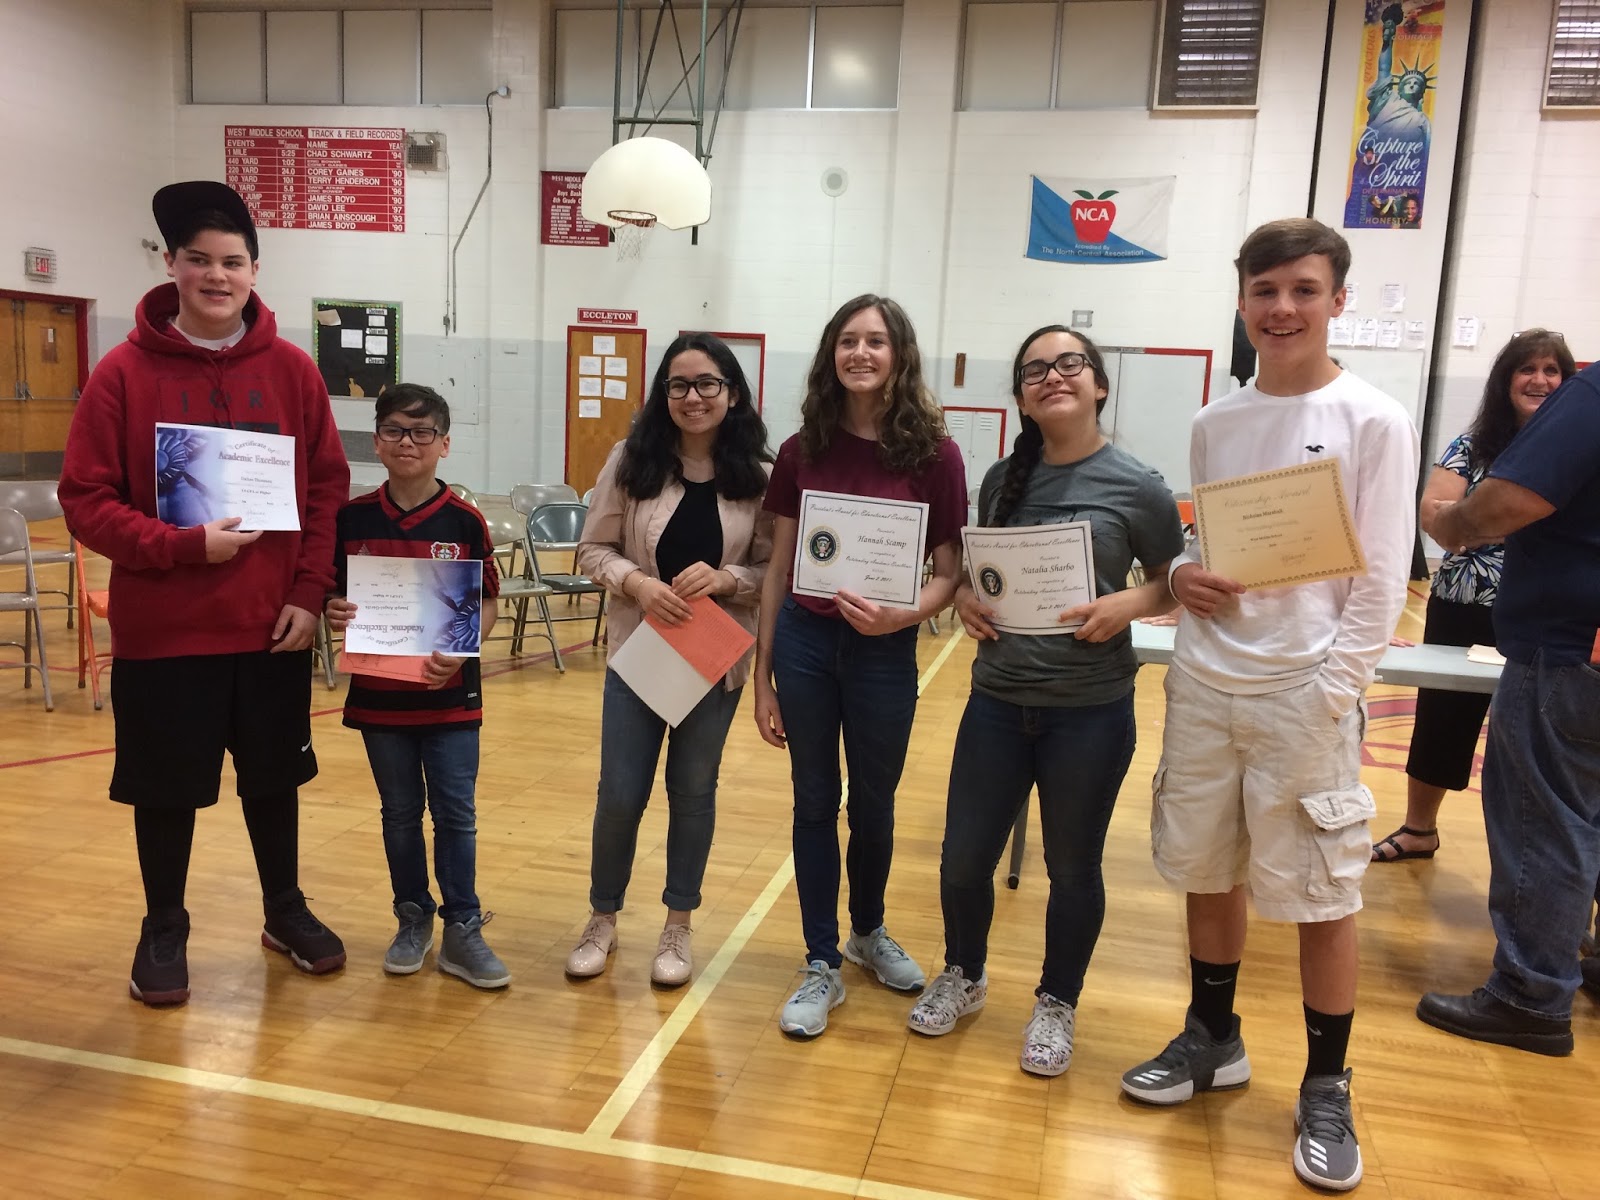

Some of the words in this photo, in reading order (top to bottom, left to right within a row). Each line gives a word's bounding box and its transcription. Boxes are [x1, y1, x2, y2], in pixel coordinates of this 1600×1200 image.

[227, 128, 246, 136] WEST
[249, 128, 273, 136] MIDDLE
[276, 129, 304, 137] SCHOOL
[346, 130, 364, 138] FIELD
[367, 130, 400, 139] RECORDS
[1358, 127, 1423, 163] Capture
[1396, 151, 1420, 170] the
[1369, 160, 1422, 189] Spirit
[1076, 208, 1109, 221] NCA
[583, 311, 632, 320] ECCLETON
[234, 441, 266, 450] Certificate
[218, 451, 253, 462] Academic
[255, 455, 290, 466] Excellence
[857, 536, 884, 544] Hannah
[884, 539, 907, 549] Scamp
[1021, 565, 1048, 575] Natalia
[1049, 563, 1074, 572] Sharbo
[350, 624, 388, 633] Excellence
[390, 625, 425, 633] Academic
[376, 637, 408, 646] Certificate
